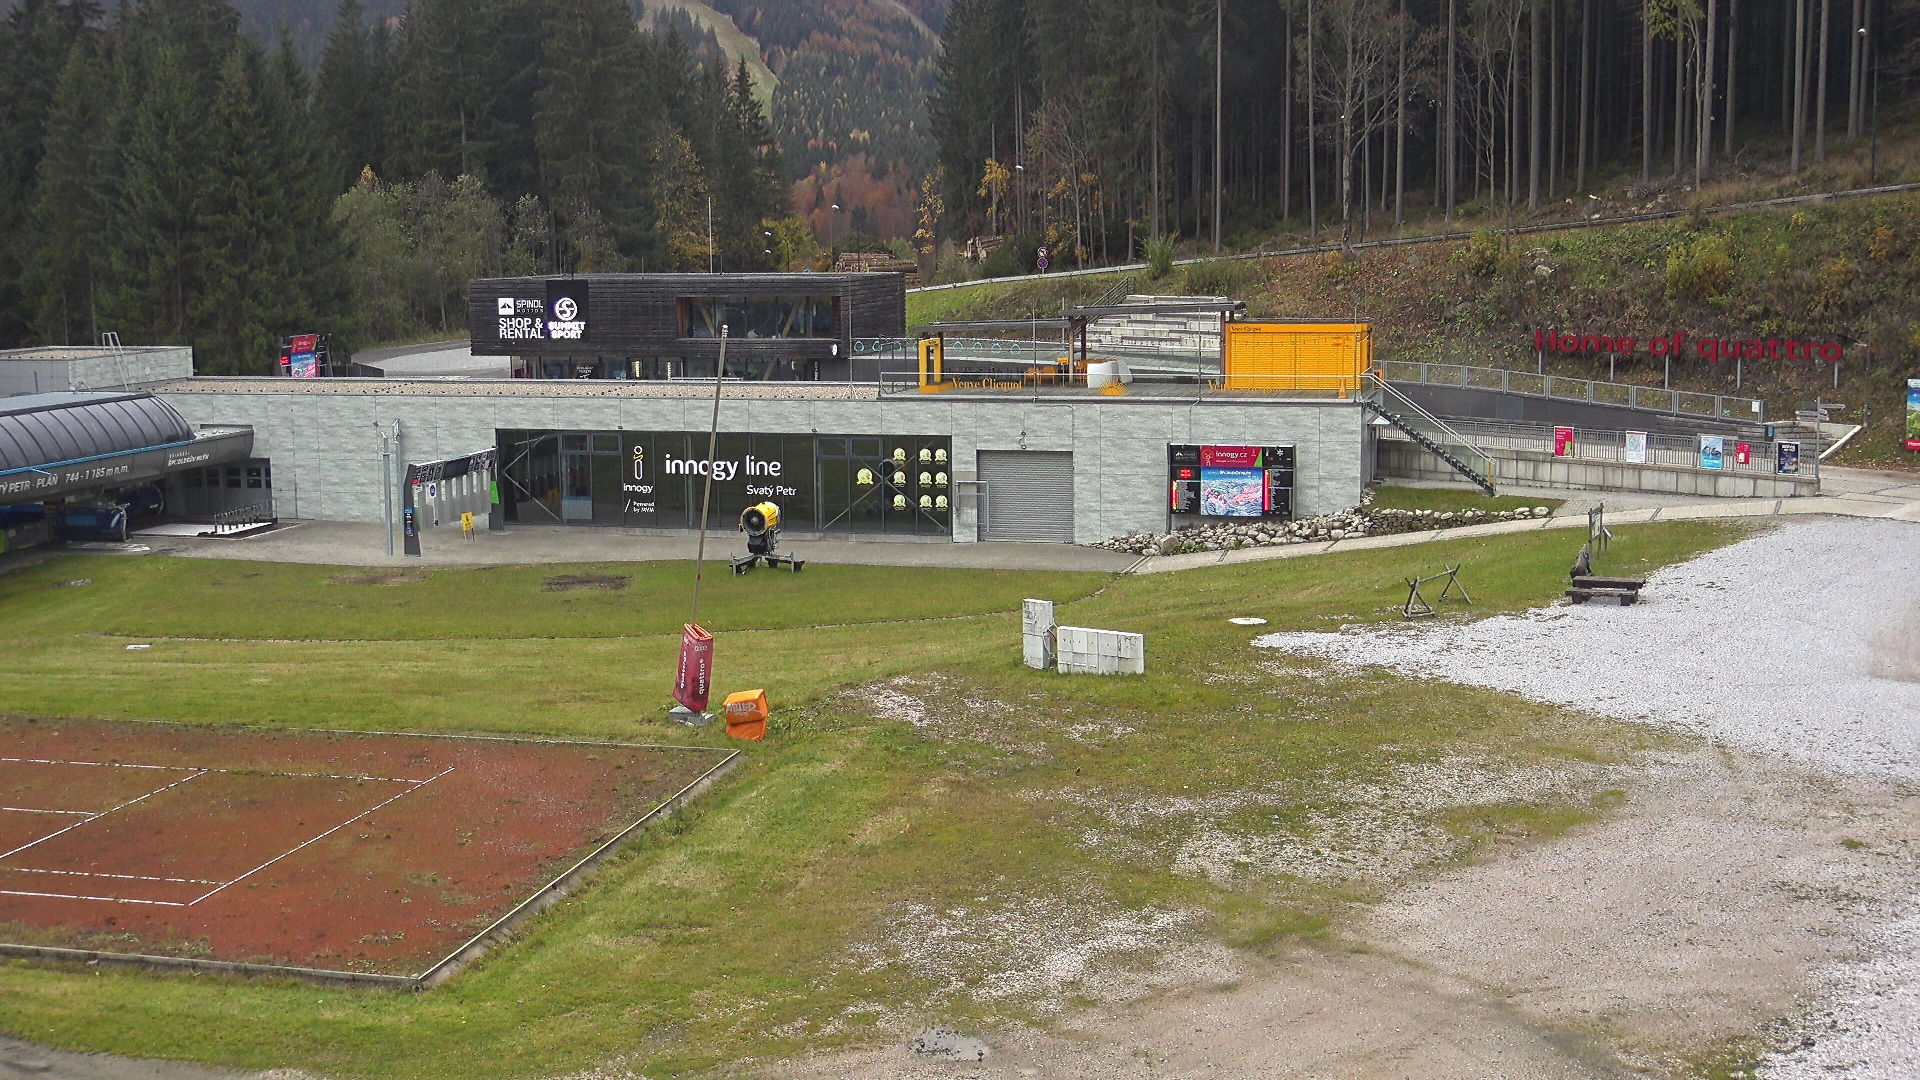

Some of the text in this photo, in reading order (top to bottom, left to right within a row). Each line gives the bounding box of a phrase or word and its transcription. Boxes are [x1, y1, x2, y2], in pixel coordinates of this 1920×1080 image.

[499, 317, 544, 329] SHOP &
[548, 321, 586, 331] SUMMIT
[499, 328, 545, 339] RENTAL
[551, 330, 583, 339] SPORT
[1534, 327, 1844, 363] Home of quattro
[665, 453, 782, 481] innogy line
[623, 482, 654, 494] innogy
[746, 484, 797, 498] Svatý Petr
